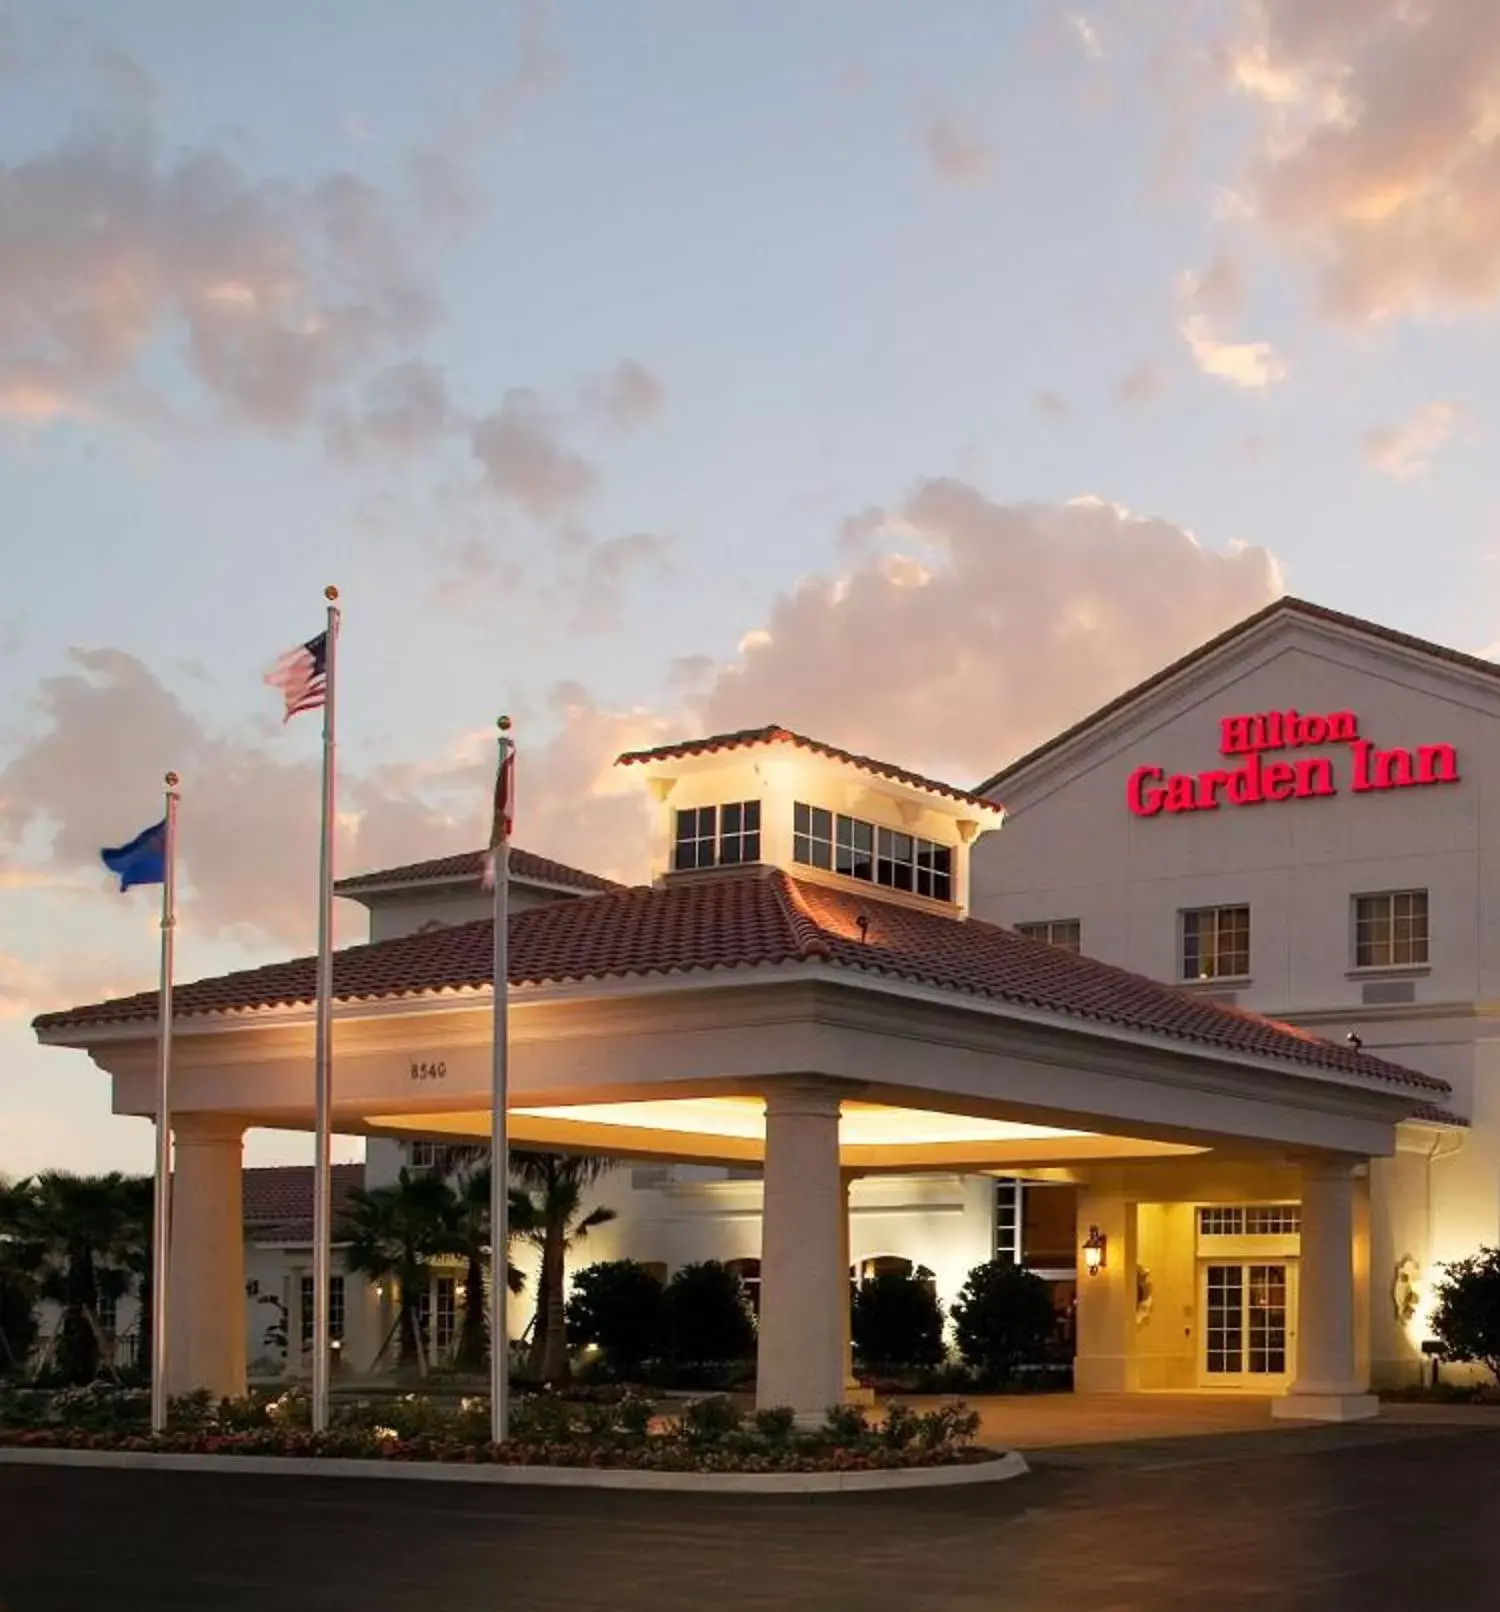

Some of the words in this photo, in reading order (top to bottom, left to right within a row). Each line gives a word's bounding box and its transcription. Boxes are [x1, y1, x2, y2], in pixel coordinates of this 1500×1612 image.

[1219, 709, 1360, 754] Hilton
[1127, 754, 1334, 816] Garden
[1350, 740, 1459, 792] Inn
[411, 1062, 447, 1079] 8540
